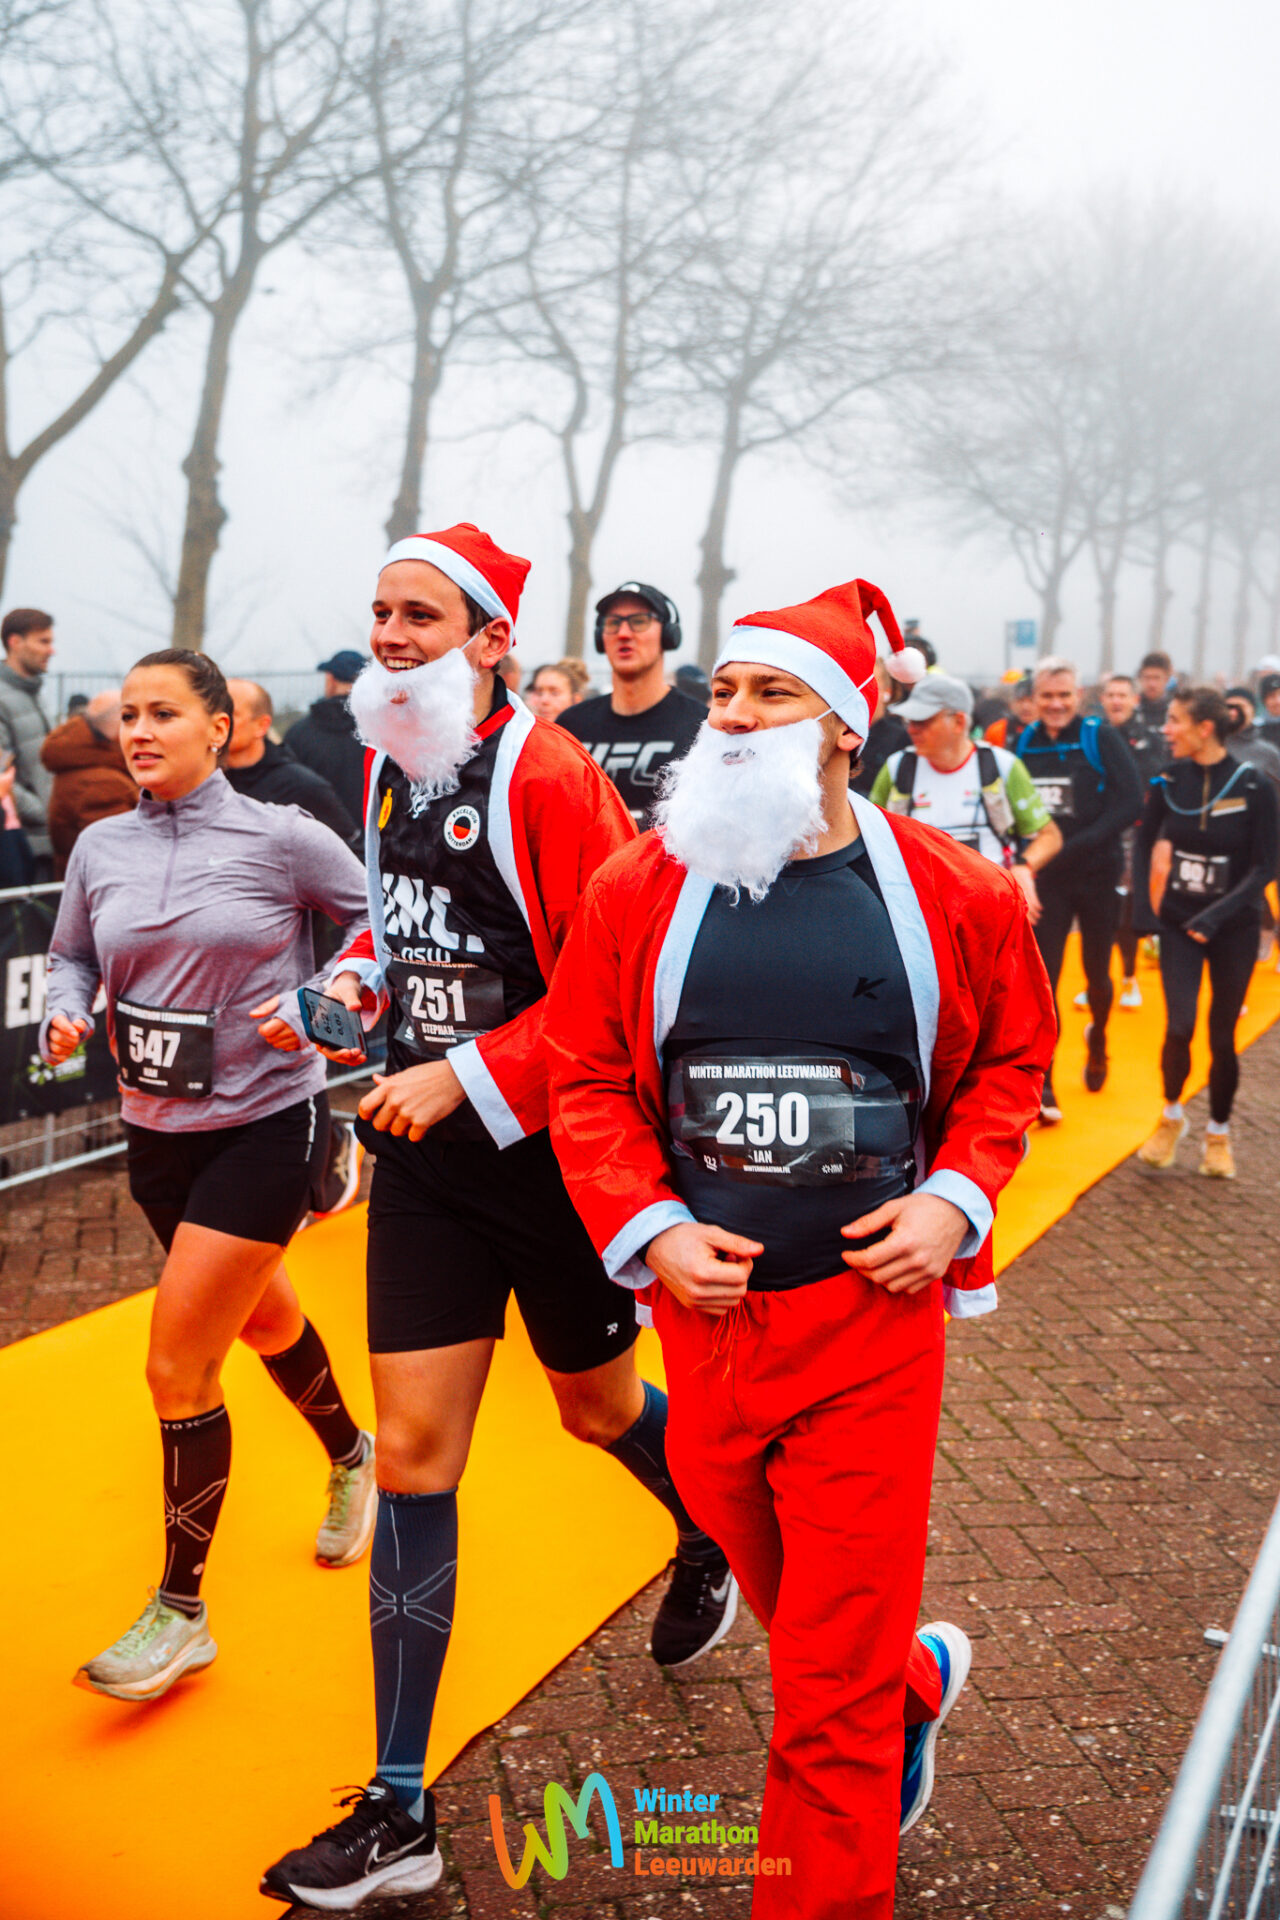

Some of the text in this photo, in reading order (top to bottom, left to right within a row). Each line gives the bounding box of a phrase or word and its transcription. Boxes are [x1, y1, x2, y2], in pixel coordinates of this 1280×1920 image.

[407, 975, 467, 1022] 251
[129, 1024, 181, 1068] 547
[689, 1065, 842, 1079] WINTER MARATHON LEEUWARDEN
[715, 1091, 810, 1147] 250
[753, 1150, 773, 1164] IAN
